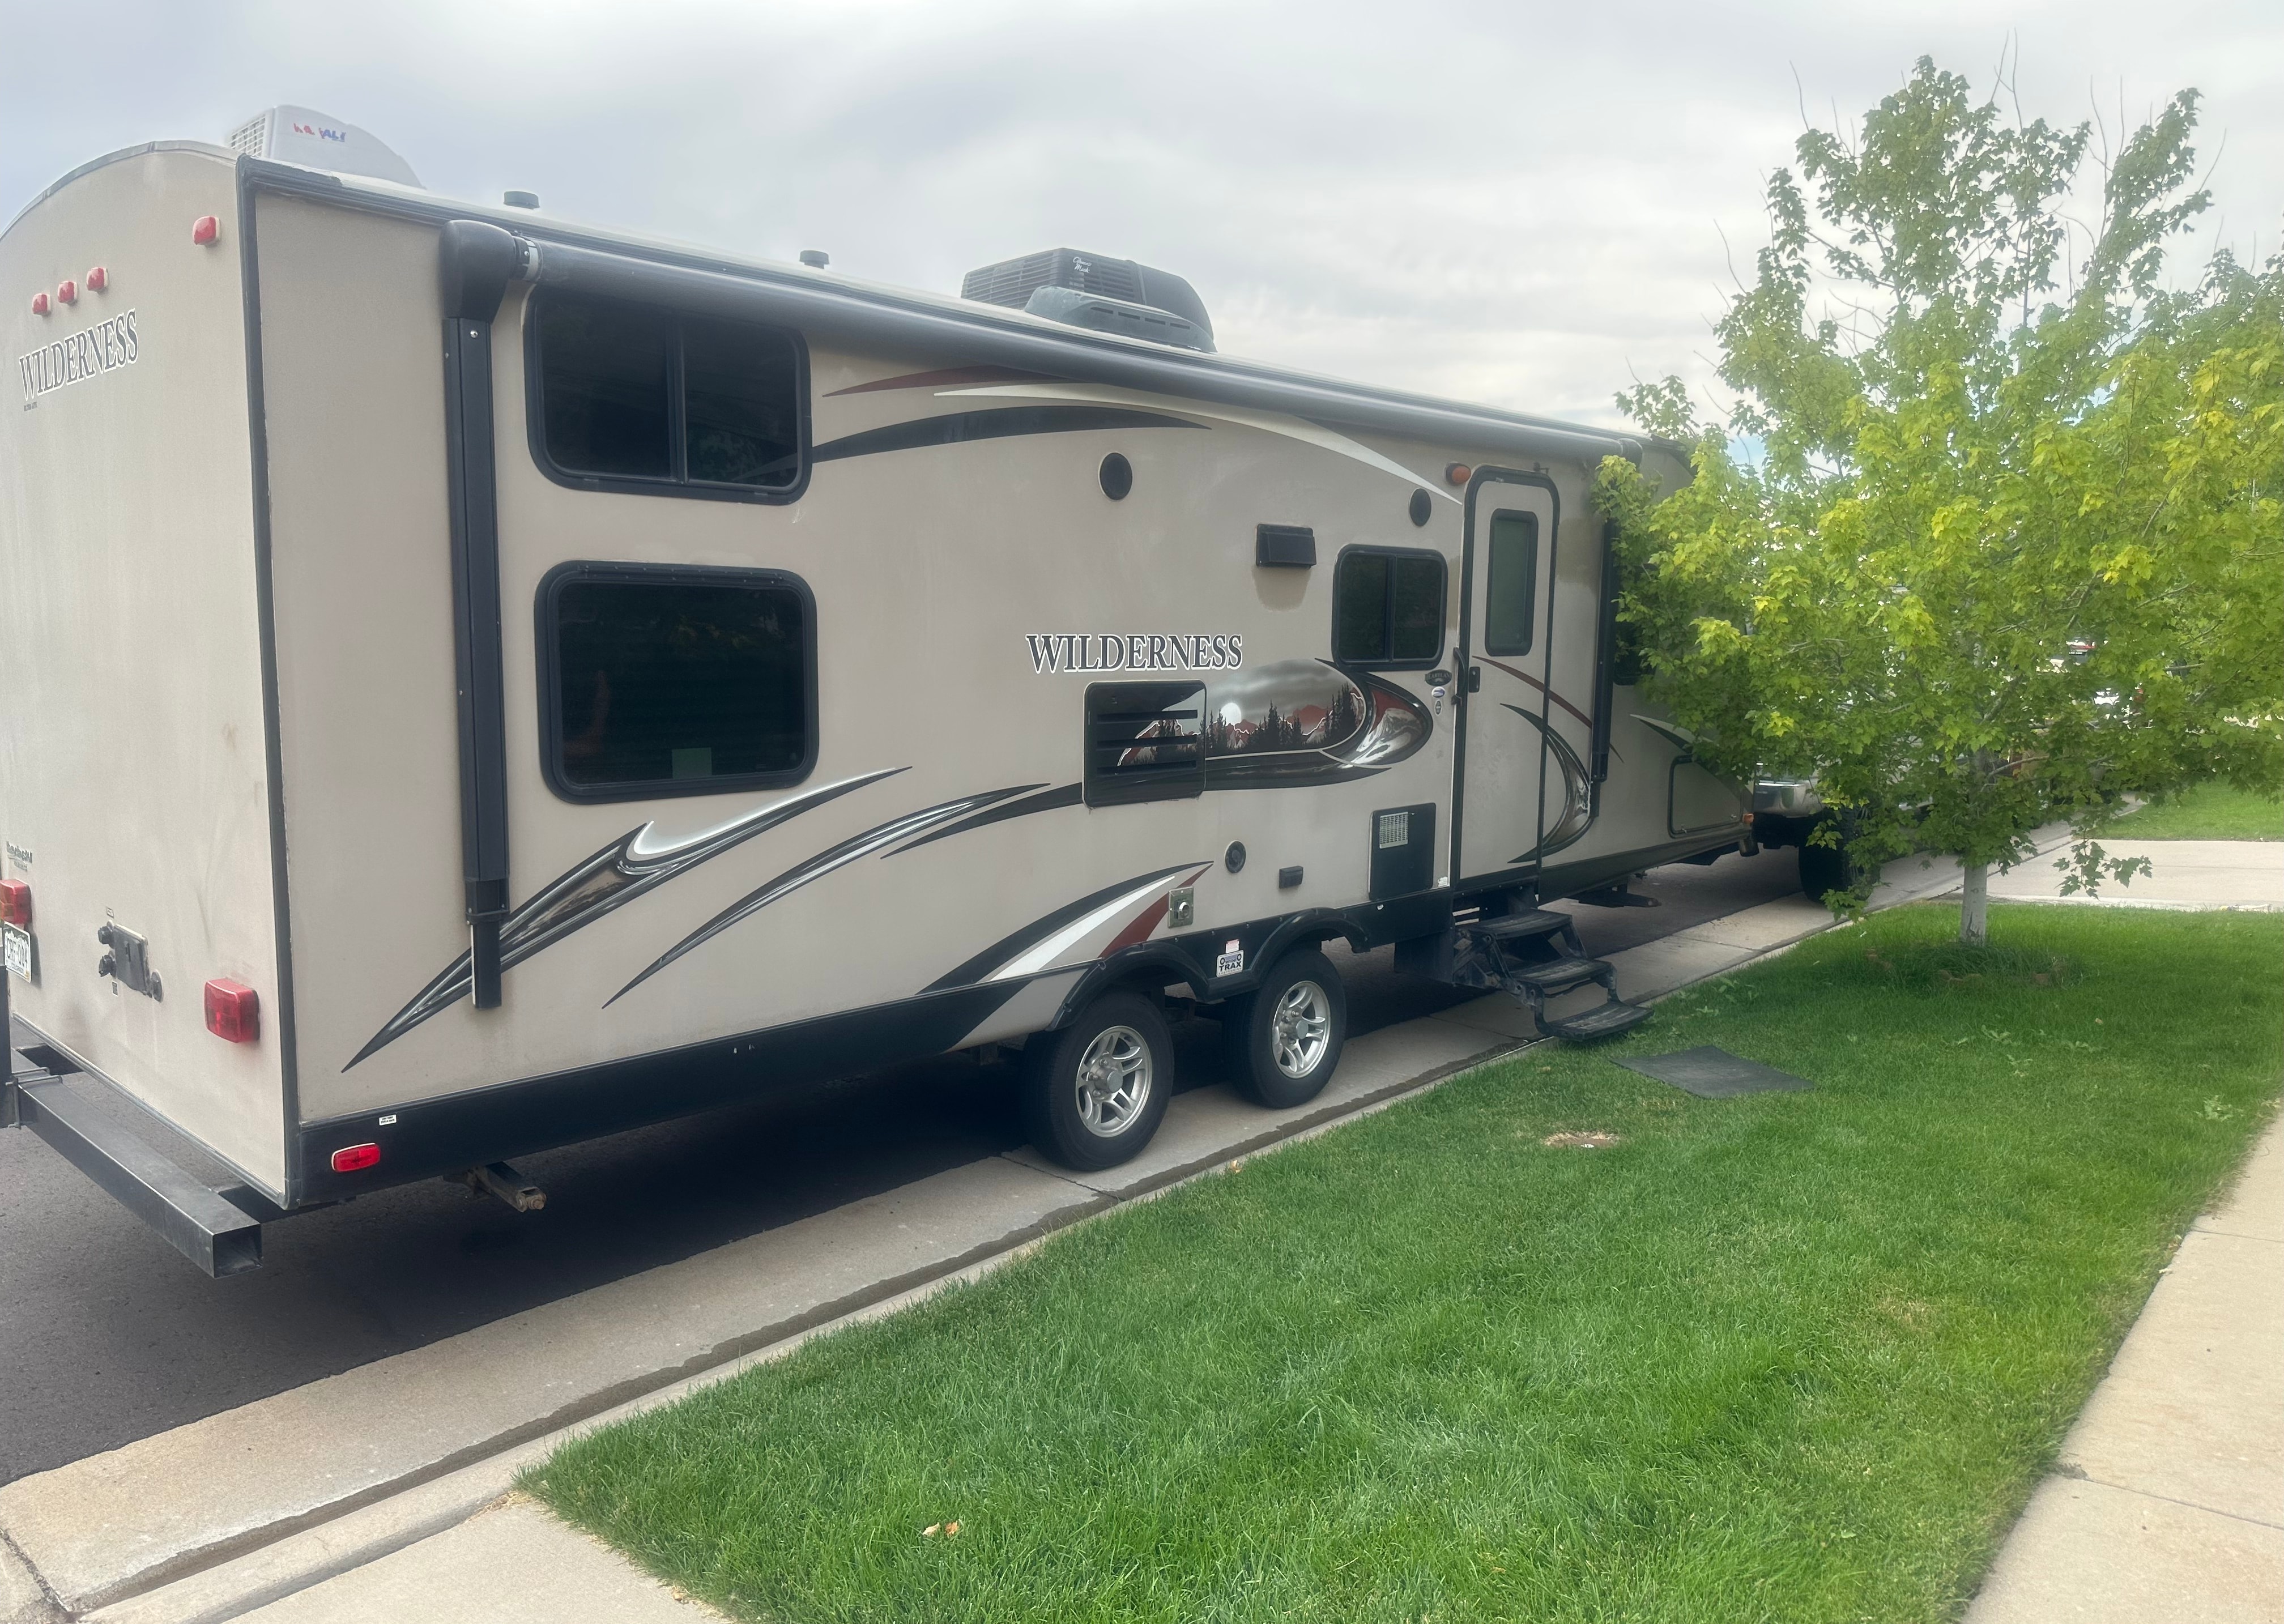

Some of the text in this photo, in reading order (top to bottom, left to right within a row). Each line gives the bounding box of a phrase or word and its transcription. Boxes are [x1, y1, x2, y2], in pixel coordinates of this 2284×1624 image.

[19, 308, 138, 401] WILDERNESS
[1025, 634, 1243, 674] WILDERNESS
[1219, 961, 1242, 972] TRAX
